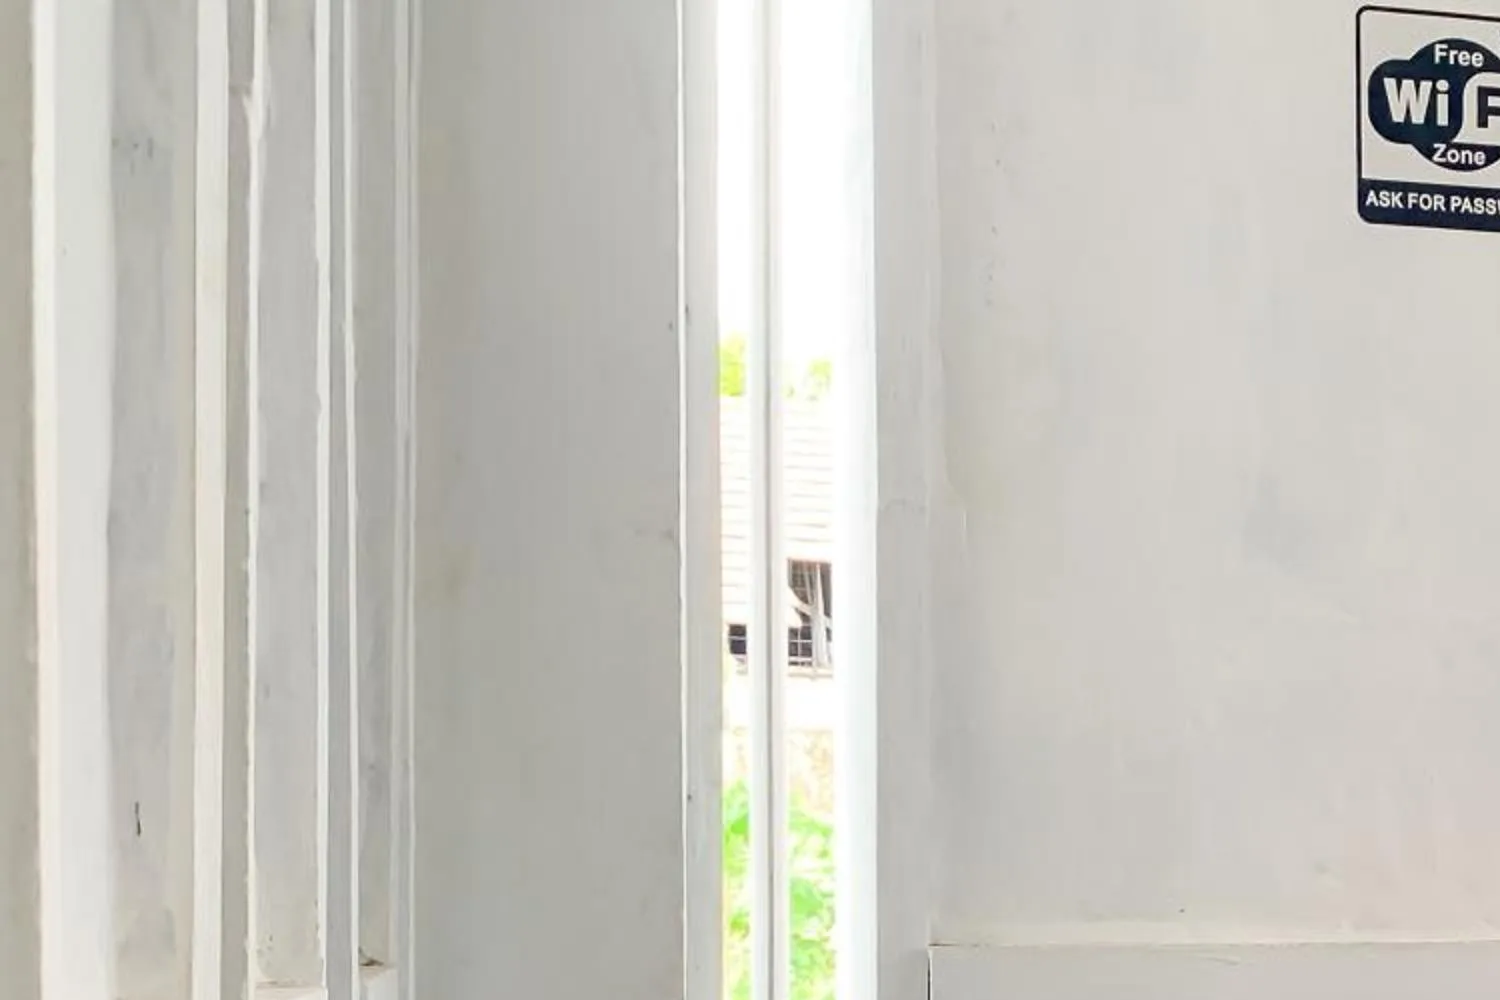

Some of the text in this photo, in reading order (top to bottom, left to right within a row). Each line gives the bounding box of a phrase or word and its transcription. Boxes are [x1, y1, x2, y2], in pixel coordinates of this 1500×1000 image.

[1433, 43, 1485, 68] Free
[1383, 77, 1449, 127] Wi
[1432, 143, 1486, 166] Zone
[1365, 190, 1404, 209] ASK
[1407, 193, 1446, 212] FOR
